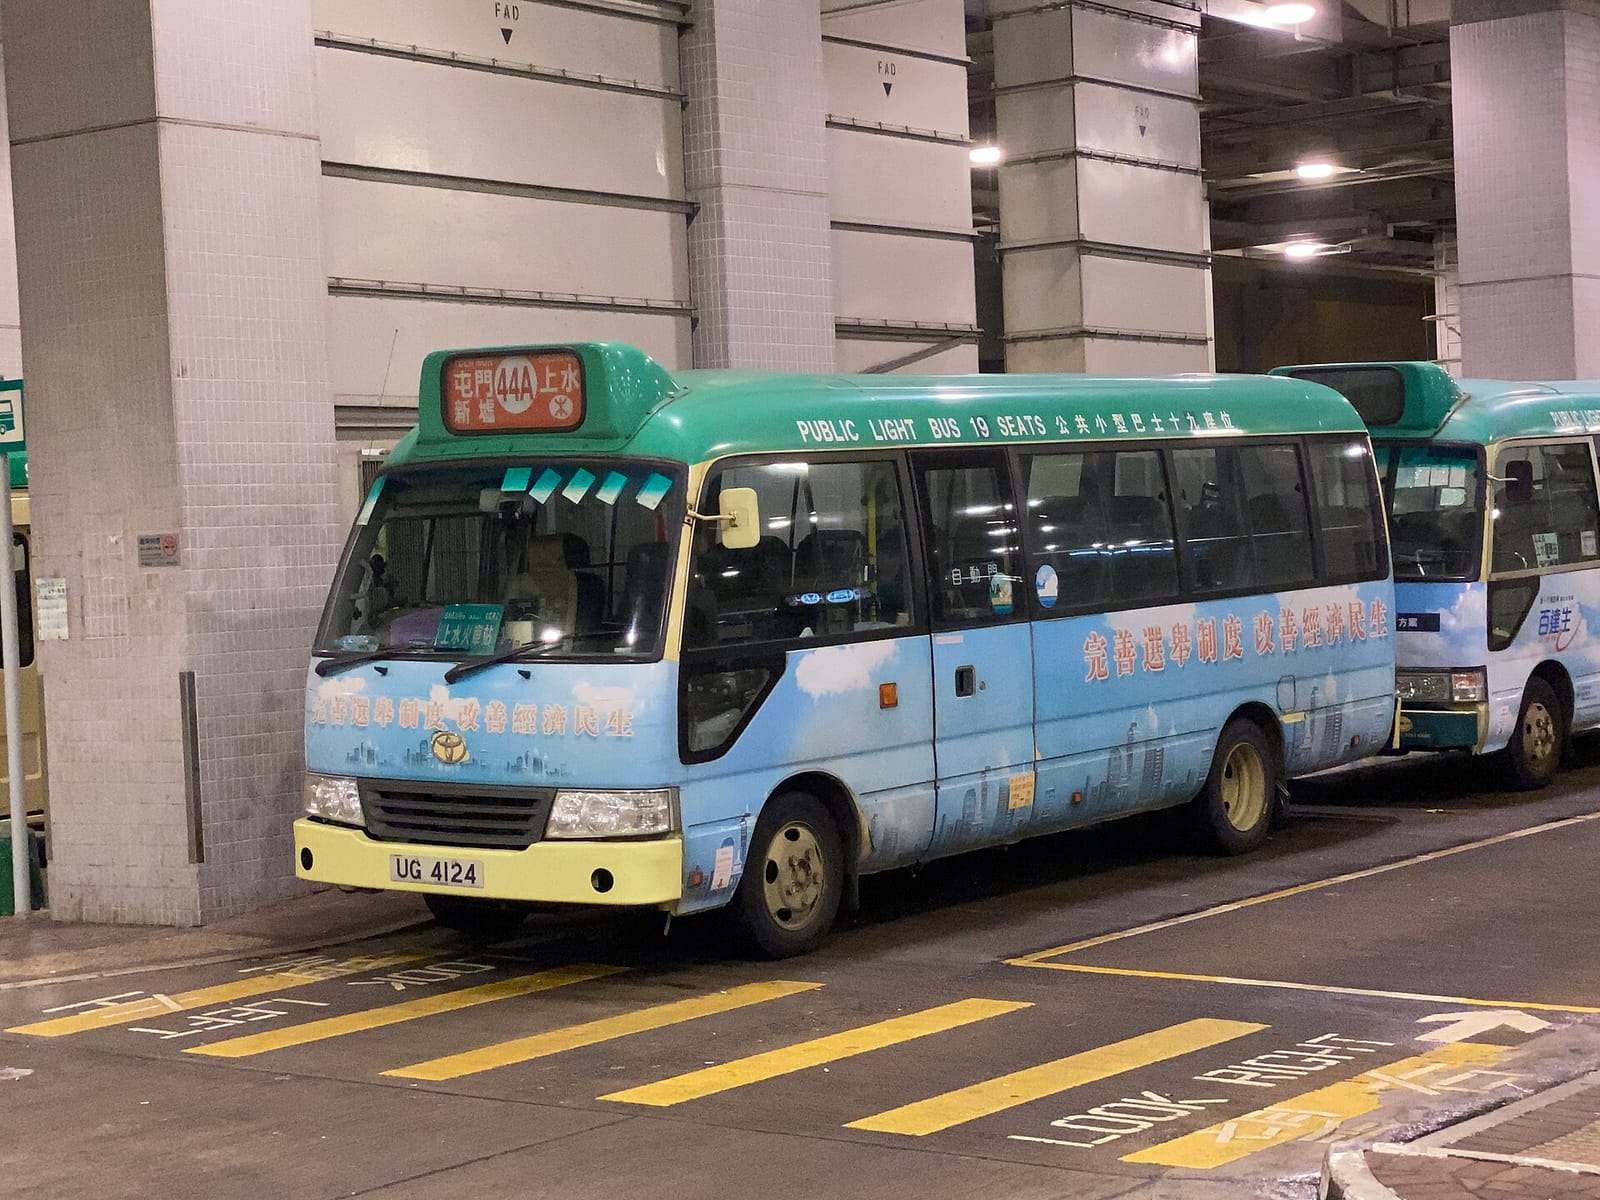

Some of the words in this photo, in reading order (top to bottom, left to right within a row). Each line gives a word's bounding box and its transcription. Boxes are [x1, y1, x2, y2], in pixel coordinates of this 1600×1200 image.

[495, 2, 519, 21] FAD
[878, 61, 896, 76] FAD
[453, 369, 493, 398] 屯門
[497, 365, 534, 402] 44A
[540, 363, 581, 393] 上水
[796, 419, 860, 443] PUBLIC
[868, 418, 917, 441] LIGHT
[927, 417, 961, 439] BUS
[969, 416, 990, 438] 19
[996, 415, 1047, 437] SEATS
[1083, 612, 1243, 682] 完善選舉制度
[1253, 600, 1389, 656] 改善經濟民生
[456, 697, 635, 737] 改善經濟民生
[396, 858, 421, 880] UG
[430, 861, 476, 884] 4124
[127, 997, 331, 1040] LEFT
[1007, 1090, 1230, 1148] LOOK
[1192, 1032, 1395, 1088] RIGHT
